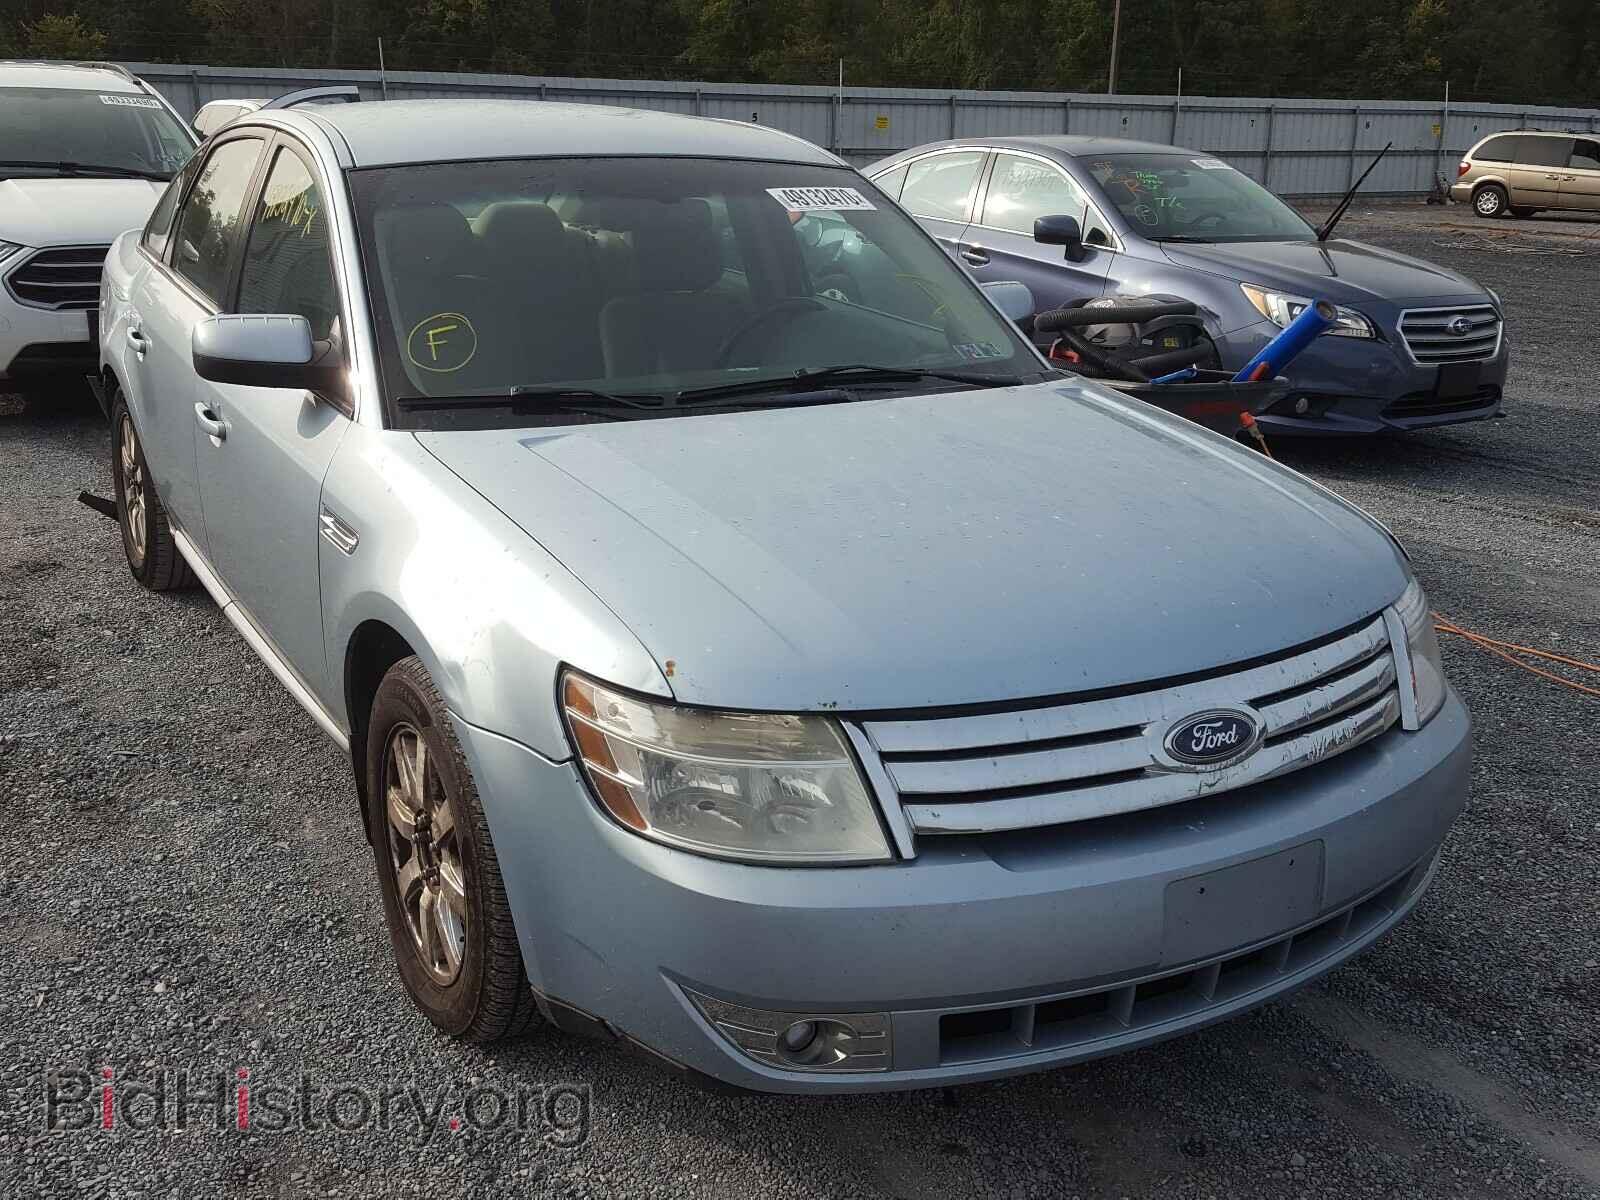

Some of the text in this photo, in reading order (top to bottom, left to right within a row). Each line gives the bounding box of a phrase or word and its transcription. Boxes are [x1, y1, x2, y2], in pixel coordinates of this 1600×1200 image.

[752, 112, 758, 122] 5
[782, 189, 863, 205] 49132470
[426, 325, 457, 361] F
[1192, 721, 1238, 751] Ford
